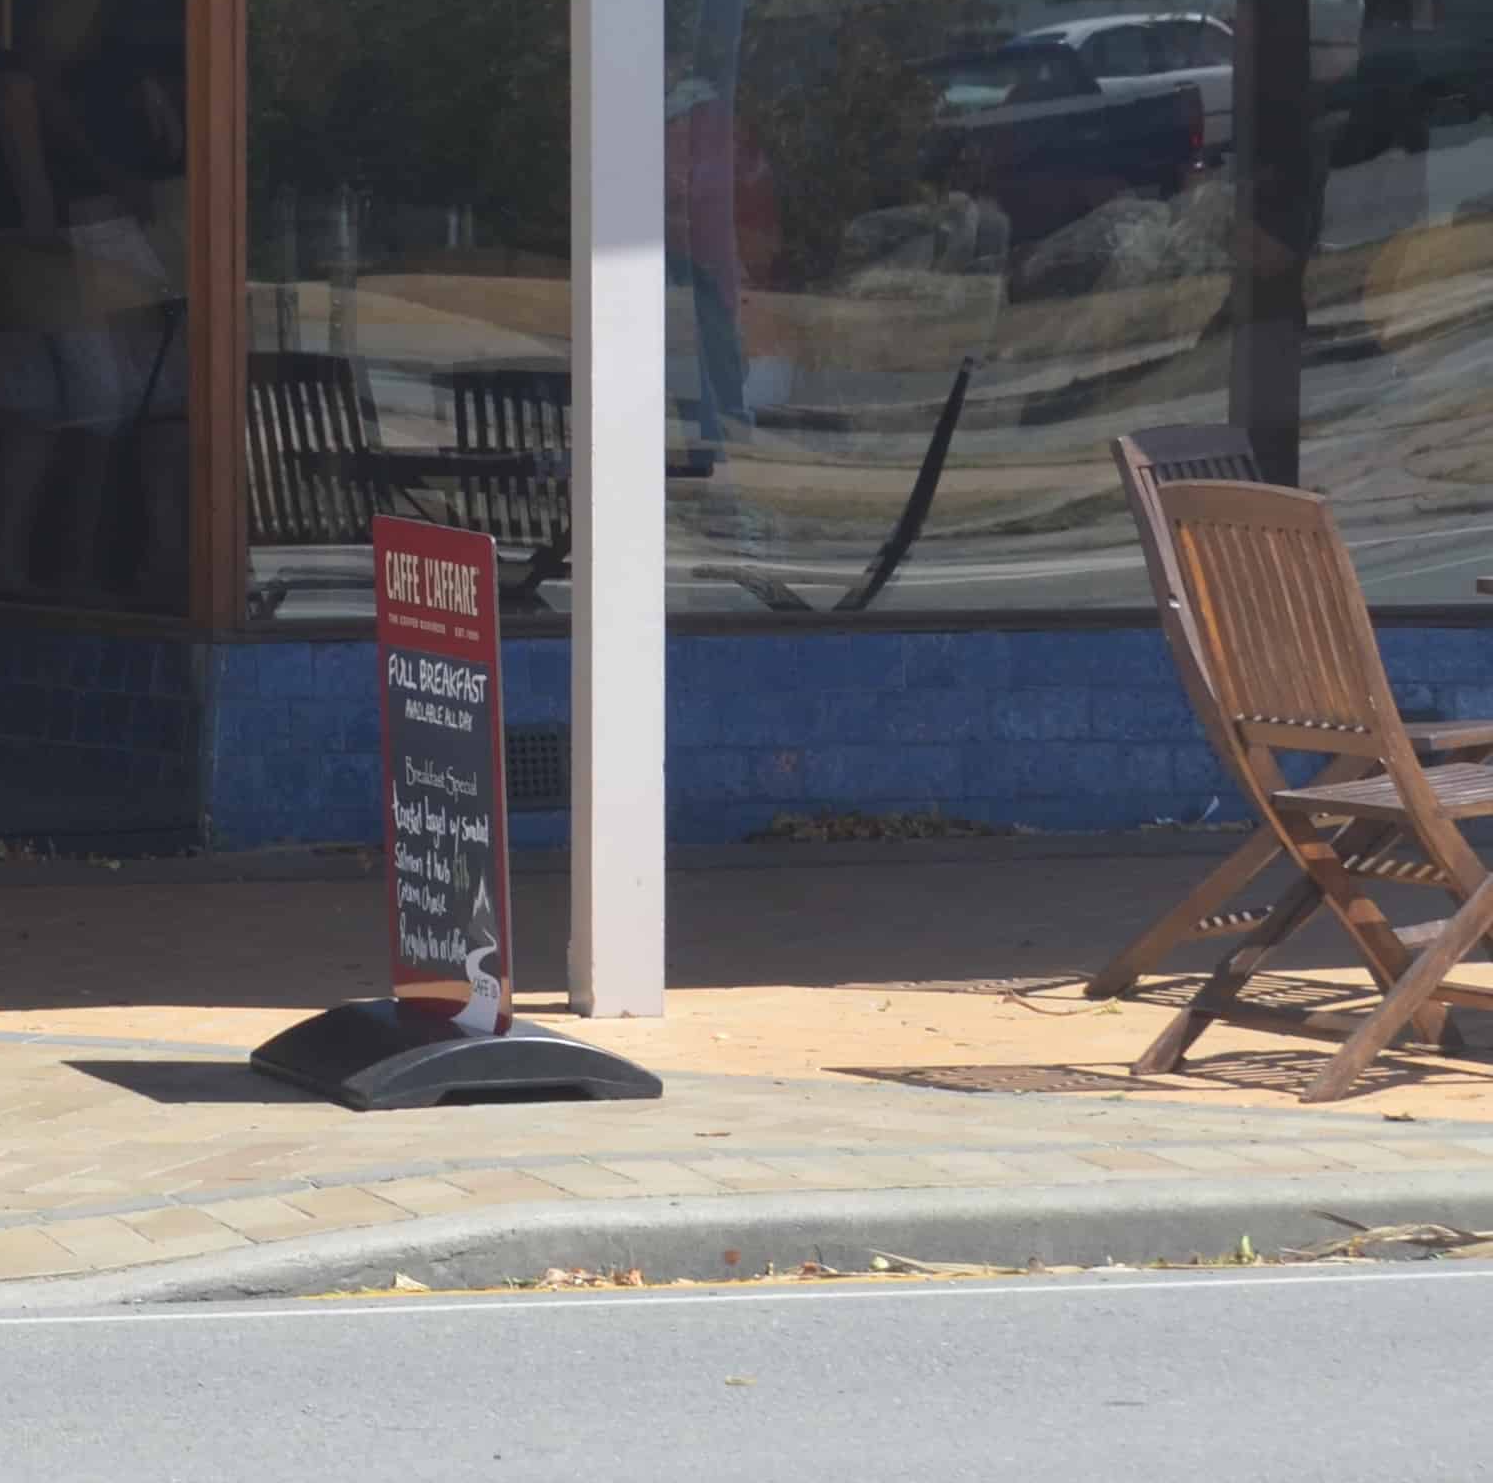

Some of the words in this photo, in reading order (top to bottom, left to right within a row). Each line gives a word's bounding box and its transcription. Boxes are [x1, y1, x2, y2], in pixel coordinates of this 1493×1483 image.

[385, 549, 421, 605] CAFFE
[424, 557, 478, 617] L'AFFARE
[388, 653, 417, 690] FULL
[419, 658, 488, 704] BREAKFAST
[405, 756, 445, 789] Breakfast
[445, 765, 478, 803] Special
